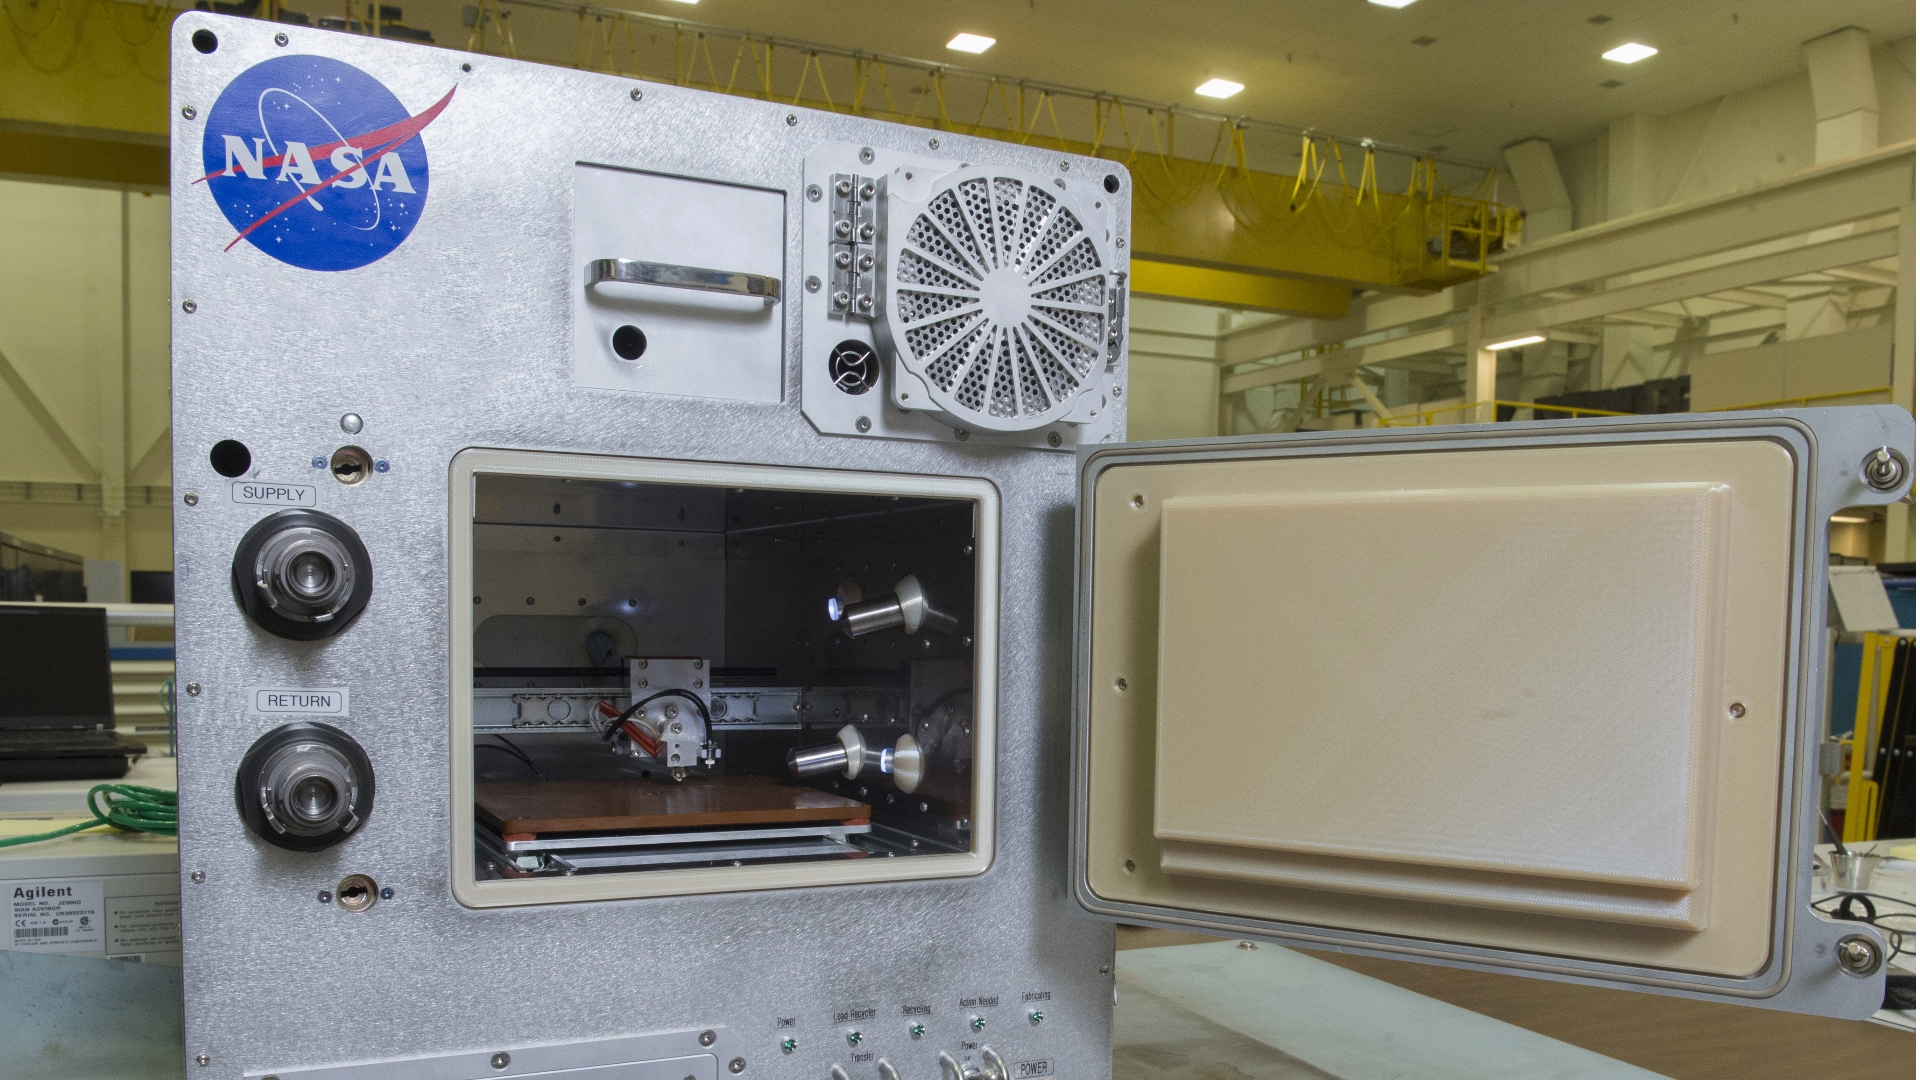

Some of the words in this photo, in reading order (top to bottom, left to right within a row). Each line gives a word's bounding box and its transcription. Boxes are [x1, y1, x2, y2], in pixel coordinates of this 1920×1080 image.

[221, 134, 417, 194] NASA
[243, 485, 305, 501] SUPPLY
[268, 694, 331, 707] RETURN
[13, 886, 72, 900] Agilent
[1022, 990, 1051, 1001] Fabricating
[959, 997, 976, 1008] Action
[978, 996, 999, 1006] Needed
[834, 1011, 848, 1021] Load
[850, 1008, 876, 1020] Recycler
[902, 1005, 931, 1015] Recycling
[777, 1017, 796, 1027] Power
[961, 1041, 978, 1050] Power
[851, 1052, 874, 1062] Transfer
[1021, 1061, 1048, 1075] POWER
